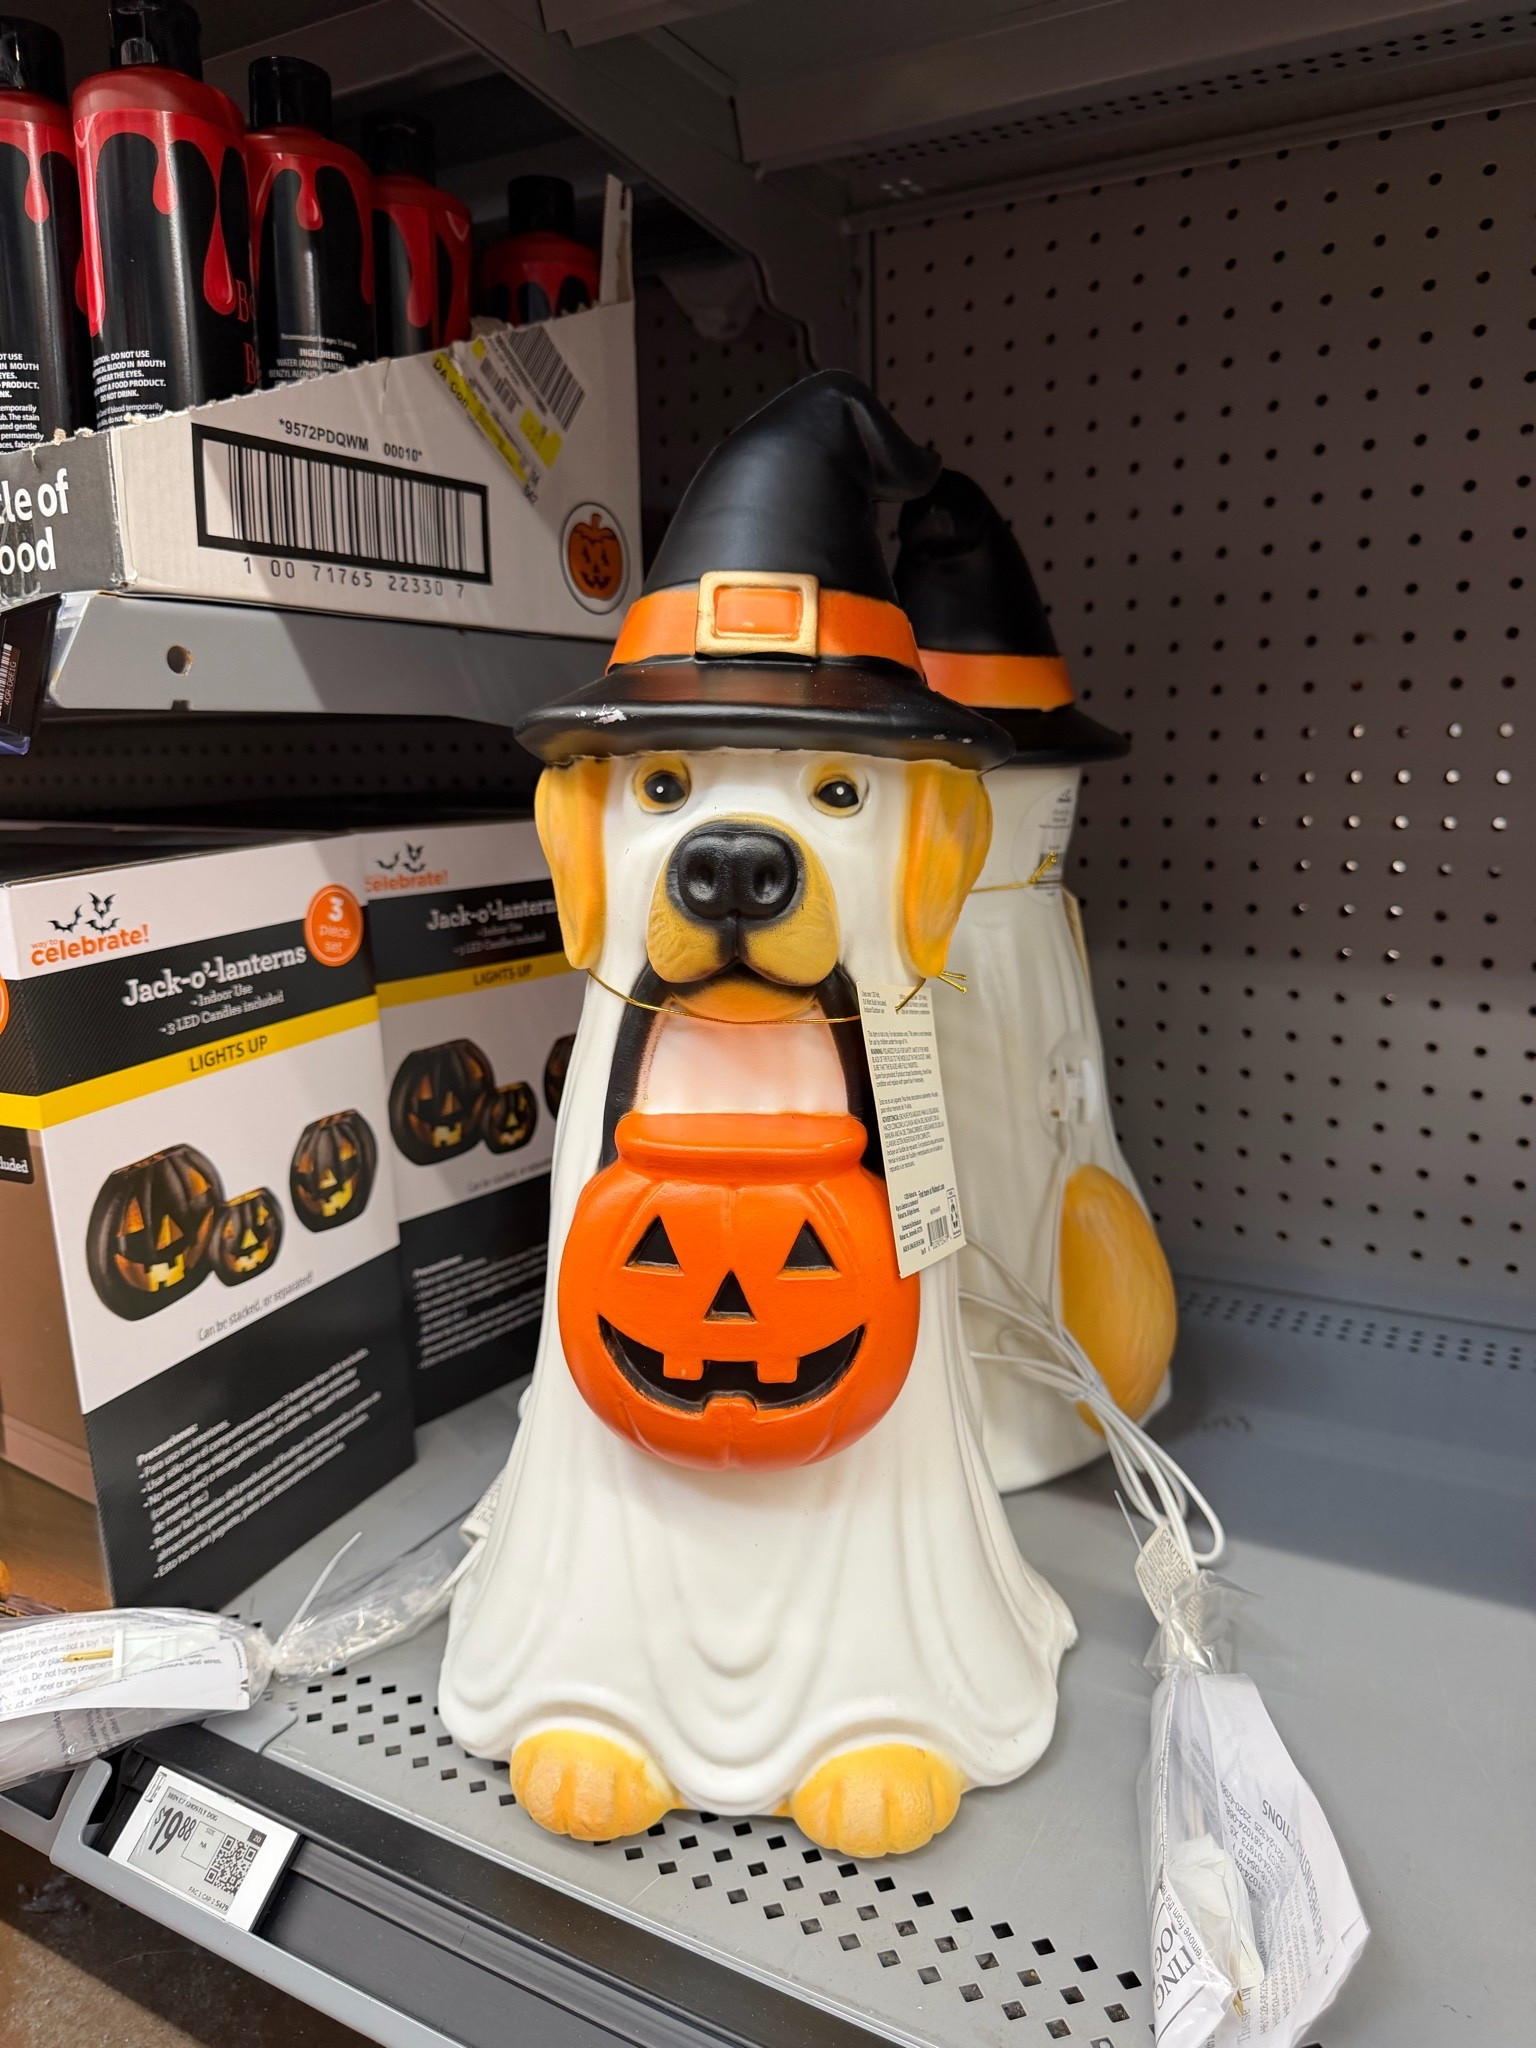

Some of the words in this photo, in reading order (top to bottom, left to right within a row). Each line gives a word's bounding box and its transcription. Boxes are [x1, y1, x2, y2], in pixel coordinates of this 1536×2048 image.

[111, 352, 120, 360] DO
[120, 351, 135, 359] NOT
[135, 350, 150, 358] USE
[276, 358, 298, 367] WATER
[299, 348, 345, 361] INGREDIENTS:
[107, 361, 126, 371] BLOOD
[137, 360, 166, 368] MOUTH
[113, 372, 125, 380] THE
[125, 370, 145, 378] EYES.
[111, 380, 129, 389] FOOD
[129, 379, 166, 387] PRODUCT.
[107, 392, 117, 400] NOT
[117, 389, 140, 399] DRINK.
[125, 402, 163, 412] temporarily
[14, 423, 37, 431] gentle
[0, 432, 44, 441] permanently
[37, 468, 69, 517] of
[243, 557, 252, 574] 1
[271, 559, 295, 579] 00
[312, 564, 373, 588] 71765
[389, 575, 443, 596] 22330
[457, 584, 465, 599] 7
[328, 896, 344, 922] 3
[31, 923, 150, 966] celebrate!
[49, 938, 58, 946] to
[473, 966, 516, 987] LIGHTS
[517, 963, 533, 978] UP
[198, 989, 233, 1007] Indoor
[233, 983, 254, 997] Use
[165, 1023, 177, 1036] 3
[176, 1014, 201, 1032] LED
[201, 1004, 243, 1023] Candles
[243, 989, 285, 1012] included
[189, 1041, 245, 1073] LIGHTS
[248, 1035, 269, 1054] UP
[185, 1800, 207, 1816] GHOSTLY
[206, 1811, 218, 1822] DOG
[204, 1827, 216, 1837] SIZE
[252, 1834, 262, 1844] 20
[188, 1886, 199, 1895] FAC
[202, 1893, 212, 1902] CAP
[1165, 1895, 1176, 1913] the
[1172, 1908, 1187, 1931] from
[1183, 1927, 1203, 1960] remove
[1237, 2008, 1251, 2046] These
